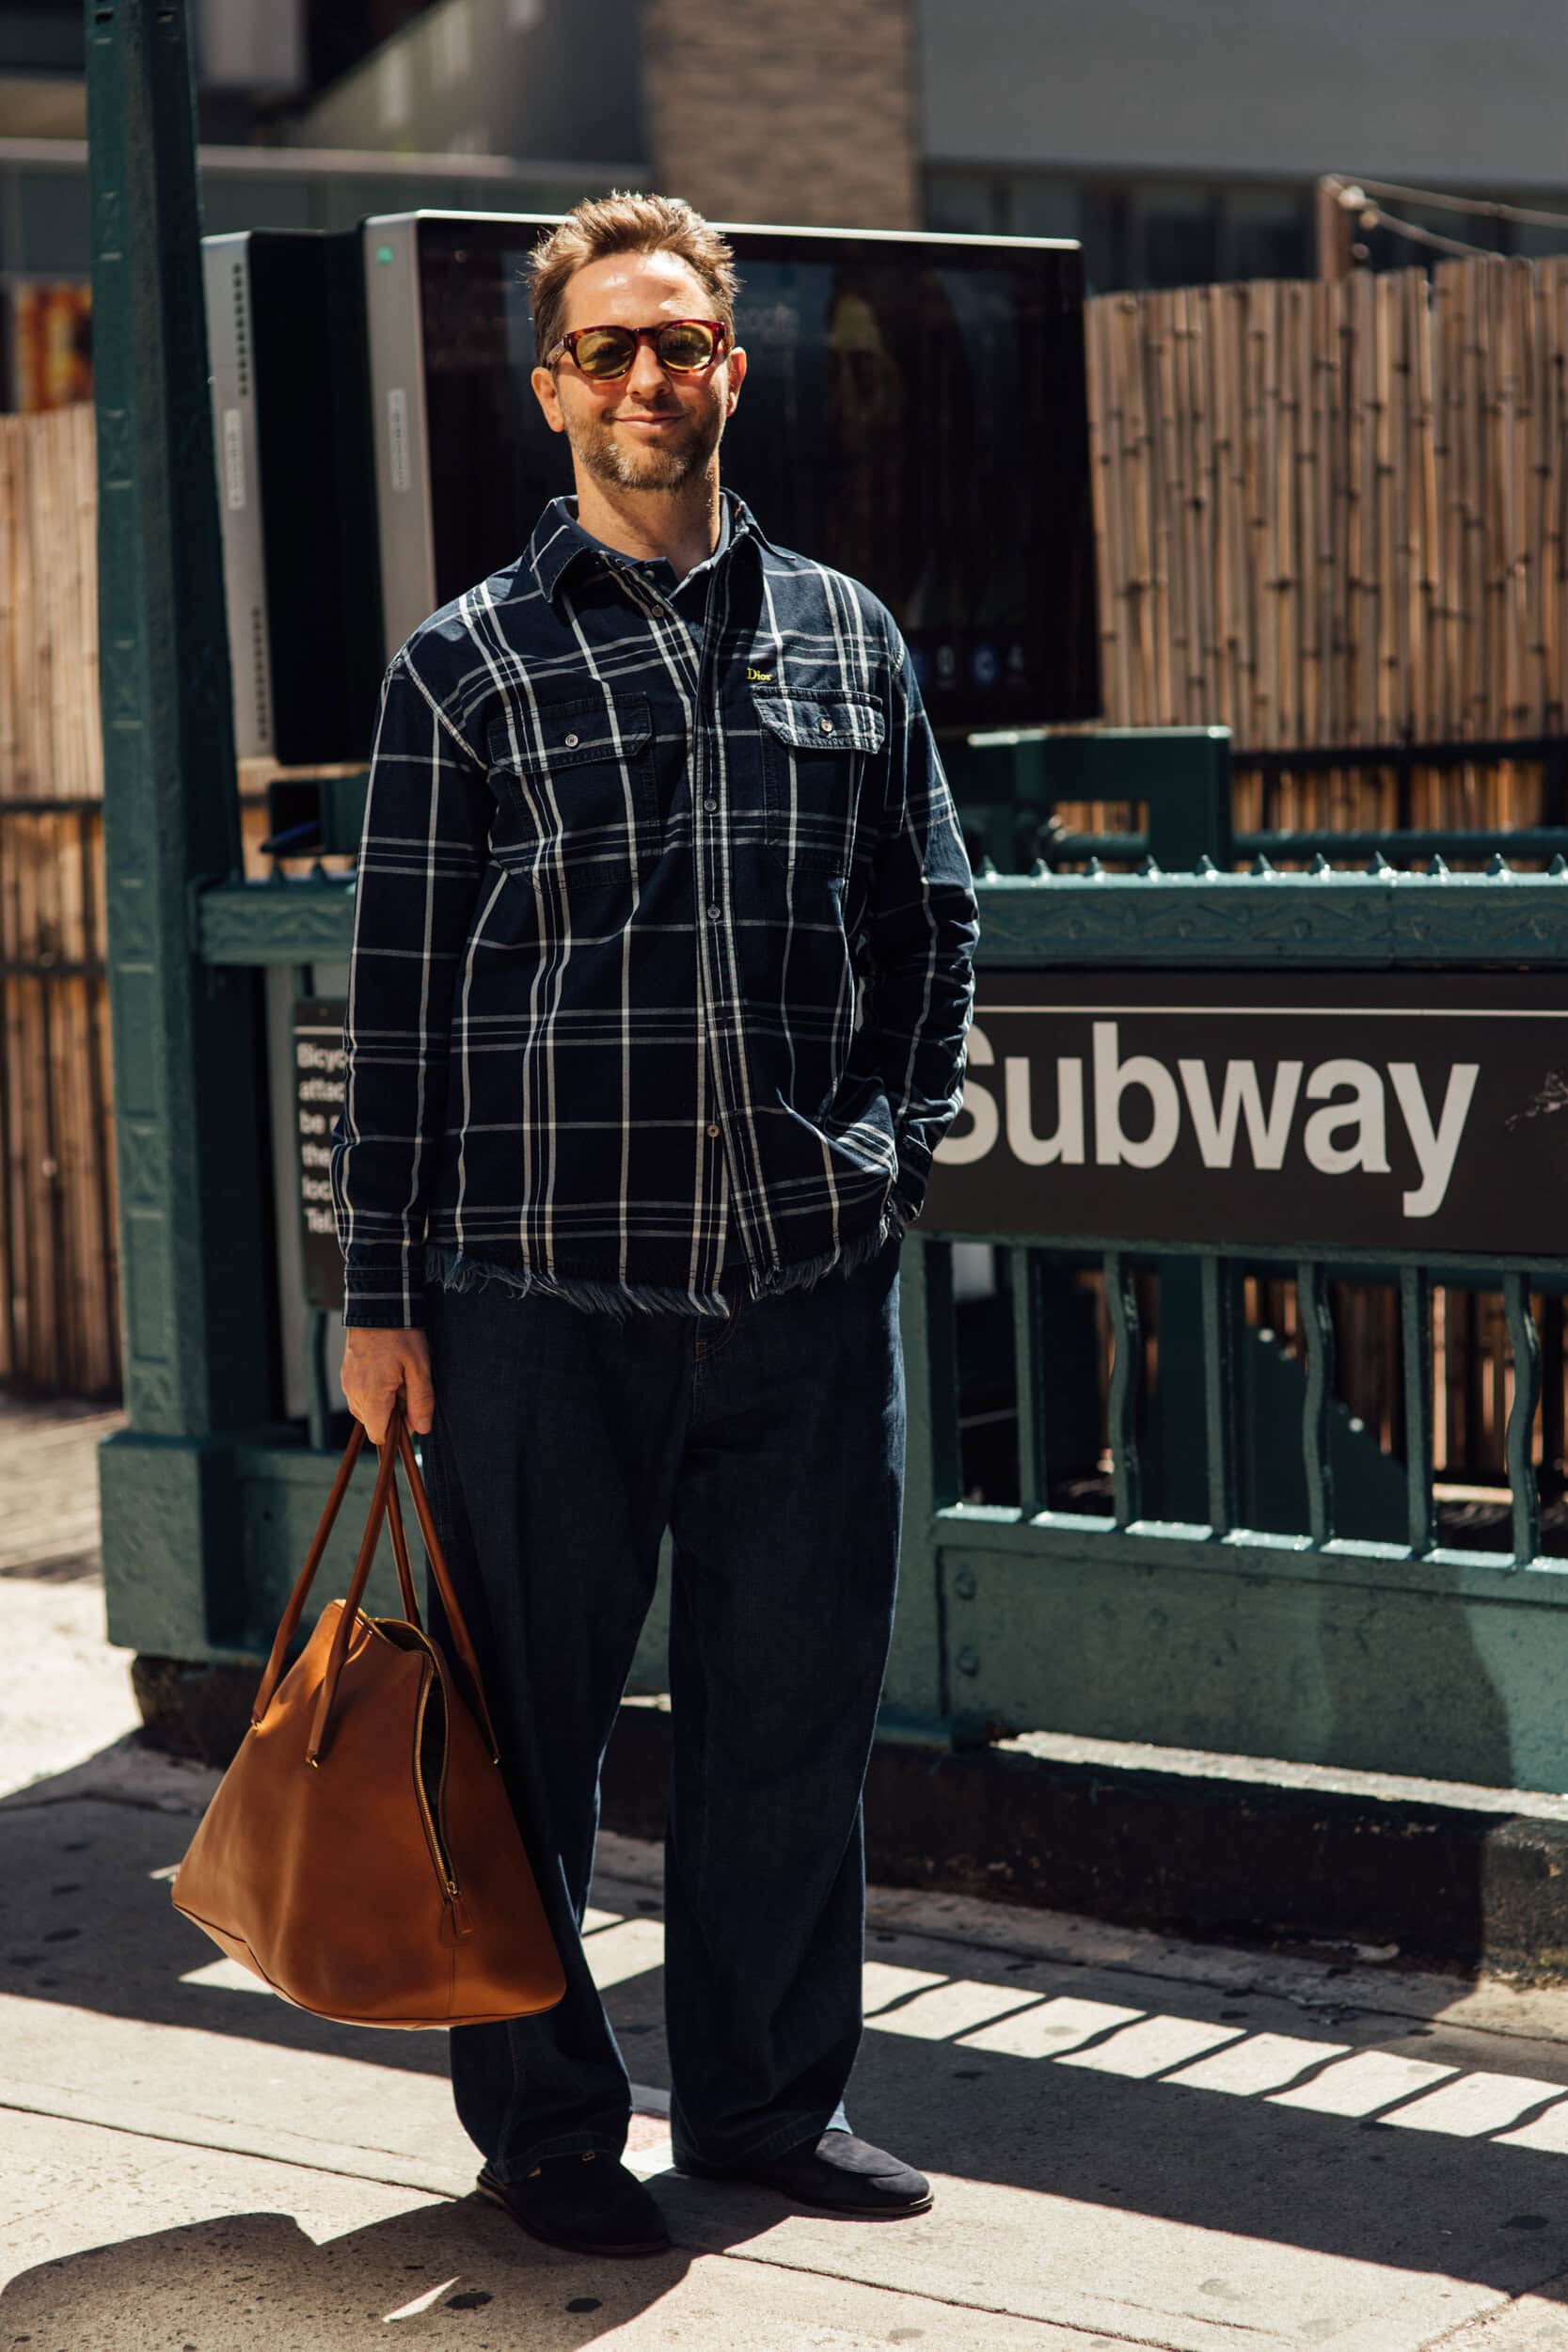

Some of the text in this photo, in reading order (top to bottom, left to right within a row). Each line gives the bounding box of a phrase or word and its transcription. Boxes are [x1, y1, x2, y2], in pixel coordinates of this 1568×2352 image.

[747, 668, 772, 681] Dior
[299, 1108, 326, 1135] be
[932, 1022, 1481, 1218] Subway
